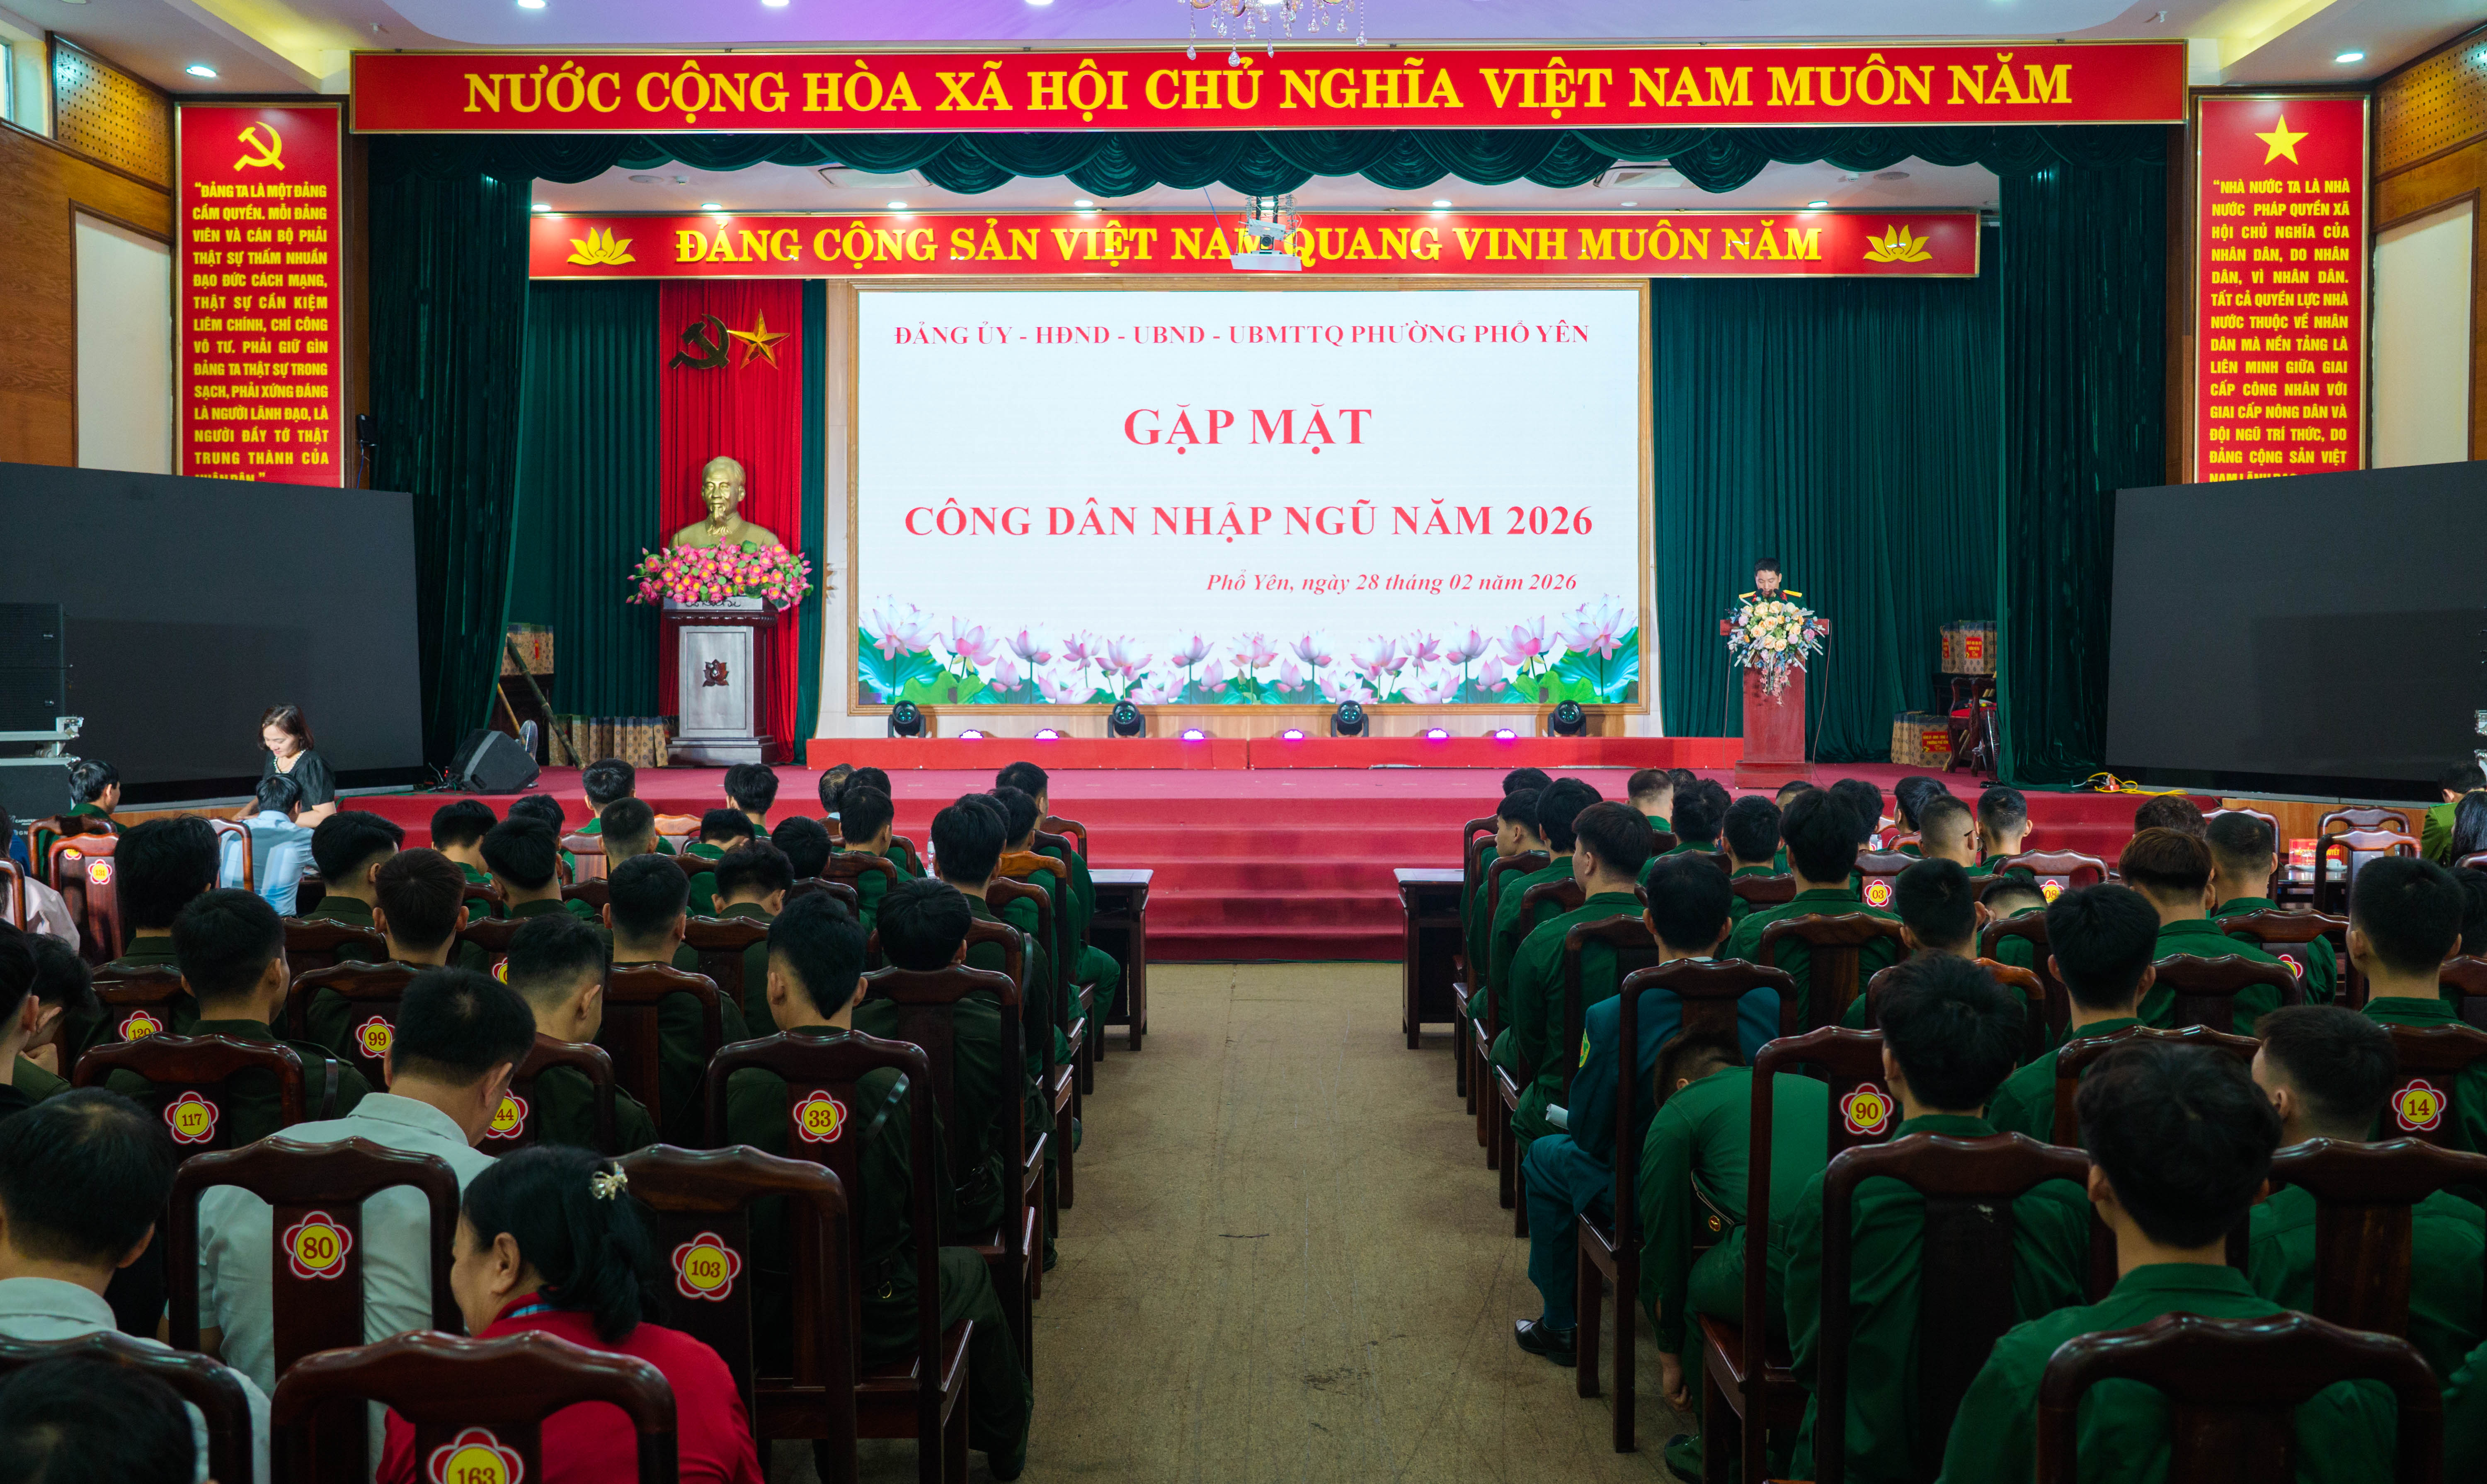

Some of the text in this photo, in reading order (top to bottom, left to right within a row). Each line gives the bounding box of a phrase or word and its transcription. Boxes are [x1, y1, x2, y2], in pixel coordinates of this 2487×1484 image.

[464, 53, 2072, 123] NƯỚC CỘNG HÒA XÃ HỘI CHỦ NGHĨA VIỆT NAM MUÔN NĂM
[235, 185, 249, 197] TA
[250, 182, 265, 197] LÀ
[267, 182, 293, 200] MỘT
[293, 181, 327, 197] ĐẢNG
[2249, 178, 2283, 194] NƯỚC
[2287, 181, 2301, 193] TA
[2305, 178, 2320, 193] LÀ
[2325, 178, 2350, 193] NHÀ
[2212, 201, 2245, 216] NƯỚC
[2254, 201, 2286, 216] PHÁP
[2333, 201, 2350, 215] XÃ
[193, 226, 327, 245] VIÊN VÀ CÁN BỘ PHẢI
[2212, 222, 2349, 241] HỘI CHỦ NGHĨA CỦA
[676, 218, 802, 261] ĐẢNG
[814, 221, 938, 269] CỘNG
[950, 218, 1040, 260] SẢN
[1051, 220, 1157, 267] VIỆT
[1456, 228, 1568, 260] VINH
[1578, 220, 1711, 260] MUÔN
[1721, 220, 1822, 259] NĂM
[2212, 246, 2349, 262] NHÂN DÂN, DO NHÂN
[193, 272, 327, 289] ĐẠO ĐỨC CÁCH MẠNG,
[2212, 269, 2349, 285] DÂN, VÌ NHÂN DÂN.
[194, 294, 225, 311] THẬT
[234, 295, 252, 311] SỰ
[294, 294, 327, 311] KIỆM
[194, 316, 327, 332] LIÊM CHÍNH, CHÍ CÔNG
[2211, 314, 2244, 329] NƯỚC
[2249, 314, 2288, 331] THUỘC
[2314, 314, 2348, 328] NHÂN
[894, 319, 1588, 346] ĐẢNG ỦY HĐND UBND UBMTTQ PHƯỜNG PHỔ YÊN
[194, 337, 327, 353] VÔ TƯ. PHẢI GIỮ GÌN
[194, 360, 327, 378] ĐẢNG TA THẬT SỰ TRONG
[2211, 358, 2347, 373] LIÊN MINH GIỮA GIAI
[194, 382, 328, 400] SẠCH, PHẢI XỨNG ĐÁNG
[2243, 381, 2277, 396] CÔNG
[2285, 381, 2319, 396] NHÂN
[2327, 381, 2347, 396] VỚI
[195, 405, 328, 422] LÀ NGƯỜI LÃNH ĐẠO, LÀ
[2210, 406, 2234, 418] GIAI
[2266, 404, 2299, 418] NÔNG
[2303, 404, 2328, 418] DÂN
[2332, 404, 2347, 418] VÀ
[1124, 403, 1372, 455] GẶP MẶT
[2209, 426, 2230, 443] ĐỘI
[2236, 426, 2261, 441] NGŨ
[2266, 426, 2285, 441] TRÍ
[2330, 428, 2346, 441] DO
[195, 448, 329, 464] TRUNG THÀNH CỦA
[2209, 447, 2347, 466] ĐẢNG CỘNG SẢN VIỆT
[904, 497, 1593, 543] CÔNG DÂN NHẬP NGŨ NĂM 2026
[1206, 569, 1246, 591] Phổ
[1302, 574, 1350, 595] ngày
[1355, 574, 1380, 590] 28
[1385, 574, 1443, 595] tháng
[1449, 574, 1473, 590] 02
[1478, 575, 1524, 591] năm
[1528, 574, 1577, 590] 2026
[1873, 890, 1883, 898] 03
[2045, 890, 2057, 899] 08
[368, 1032, 386, 1046] 99
[494, 1108, 514, 1121] 44
[1856, 1103, 1878, 1119] 90
[2409, 1099, 2429, 1116] 14
[182, 1114, 201, 1126] 117
[809, 1110, 831, 1127] 33
[303, 1237, 333, 1259] 80
[692, 1260, 720, 1278] 103
[458, 1468, 496, 1484] 163
